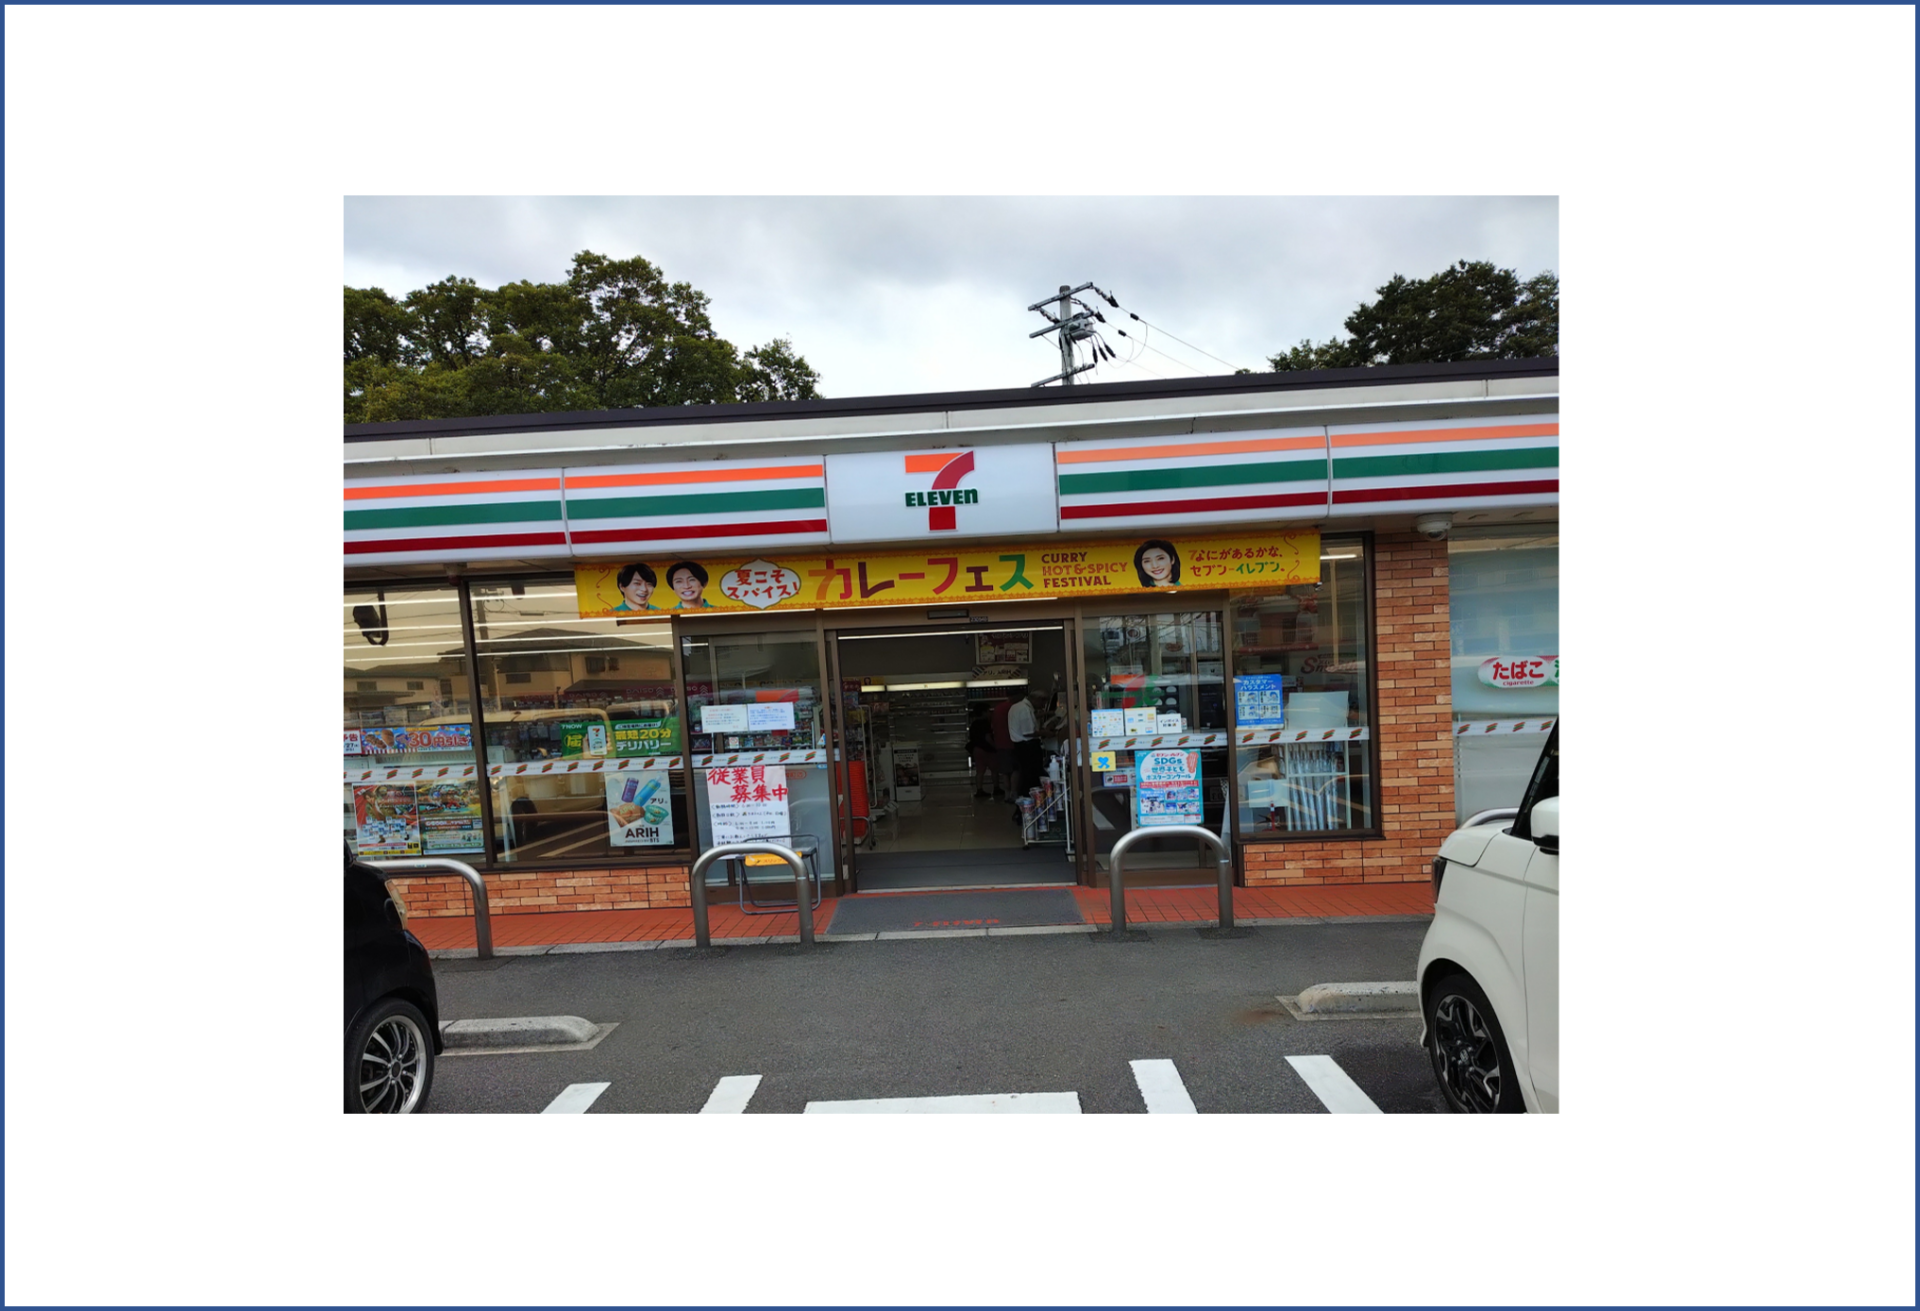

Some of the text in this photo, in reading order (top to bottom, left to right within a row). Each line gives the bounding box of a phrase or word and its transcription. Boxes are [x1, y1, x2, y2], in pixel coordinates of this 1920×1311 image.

[1041, 551, 1088, 564] CURRY
[735, 569, 786, 586] 夏こそ
[808, 554, 1034, 600] カレーフェス
[1044, 574, 1112, 589] FESTIVAL
[727, 582, 800, 600] スパイス!
[1493, 660, 1544, 681] たばこ
[615, 728, 672, 741] 最短20分
[616, 740, 672, 751] デリバリー
[1154, 757, 1183, 765] SDGs
[707, 765, 767, 785] 従業員
[730, 784, 789, 803] 募集中
[625, 827, 660, 838] ARIH
